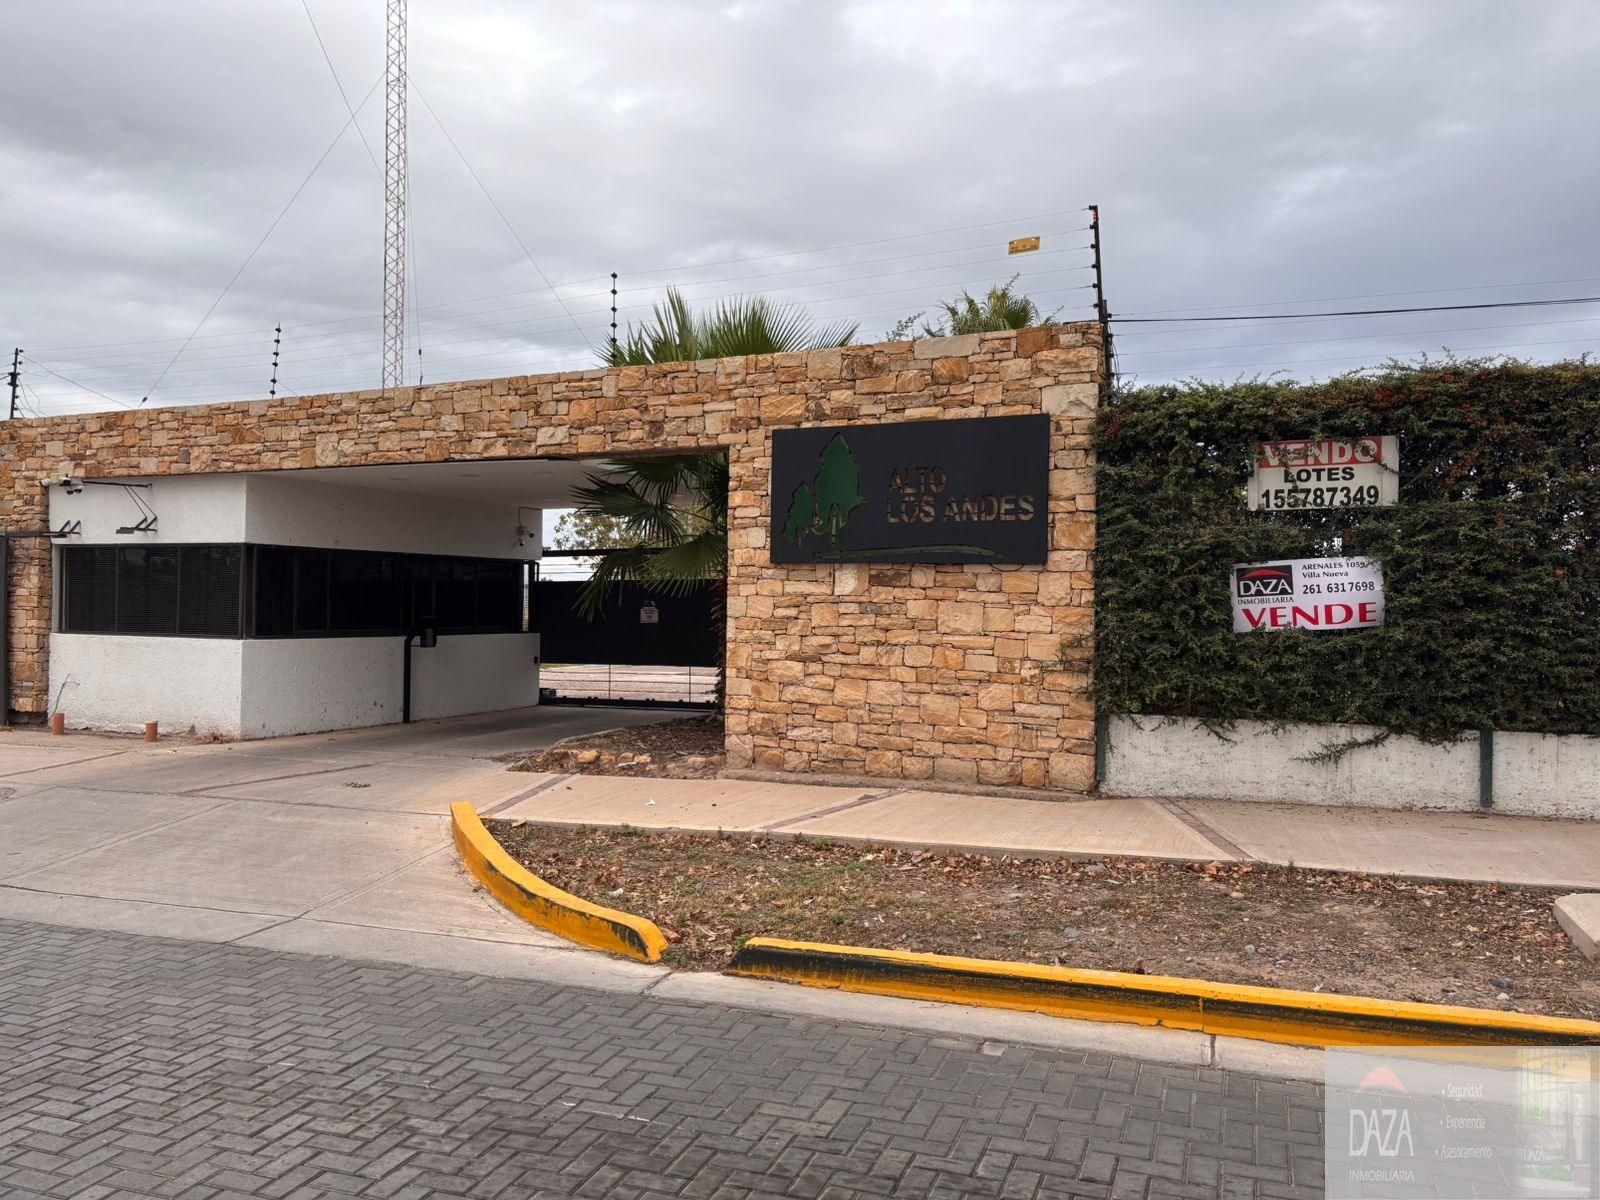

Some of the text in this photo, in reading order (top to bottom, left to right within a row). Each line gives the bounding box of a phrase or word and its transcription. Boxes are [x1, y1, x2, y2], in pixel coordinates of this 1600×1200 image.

[1263, 439, 1378, 466] VENDO
[889, 466, 947, 494] ALTO
[1283, 466, 1355, 483] LOTES
[1261, 485, 1380, 508] 155787349
[886, 495, 1035, 524] LOS ANDES
[1301, 562, 1343, 570] ARENALES
[1240, 578, 1293, 596] DAZA
[1302, 584, 1322, 594] 261
[1237, 596, 1295, 605] INMOBILIARIA
[1241, 602, 1377, 628] VENDE
